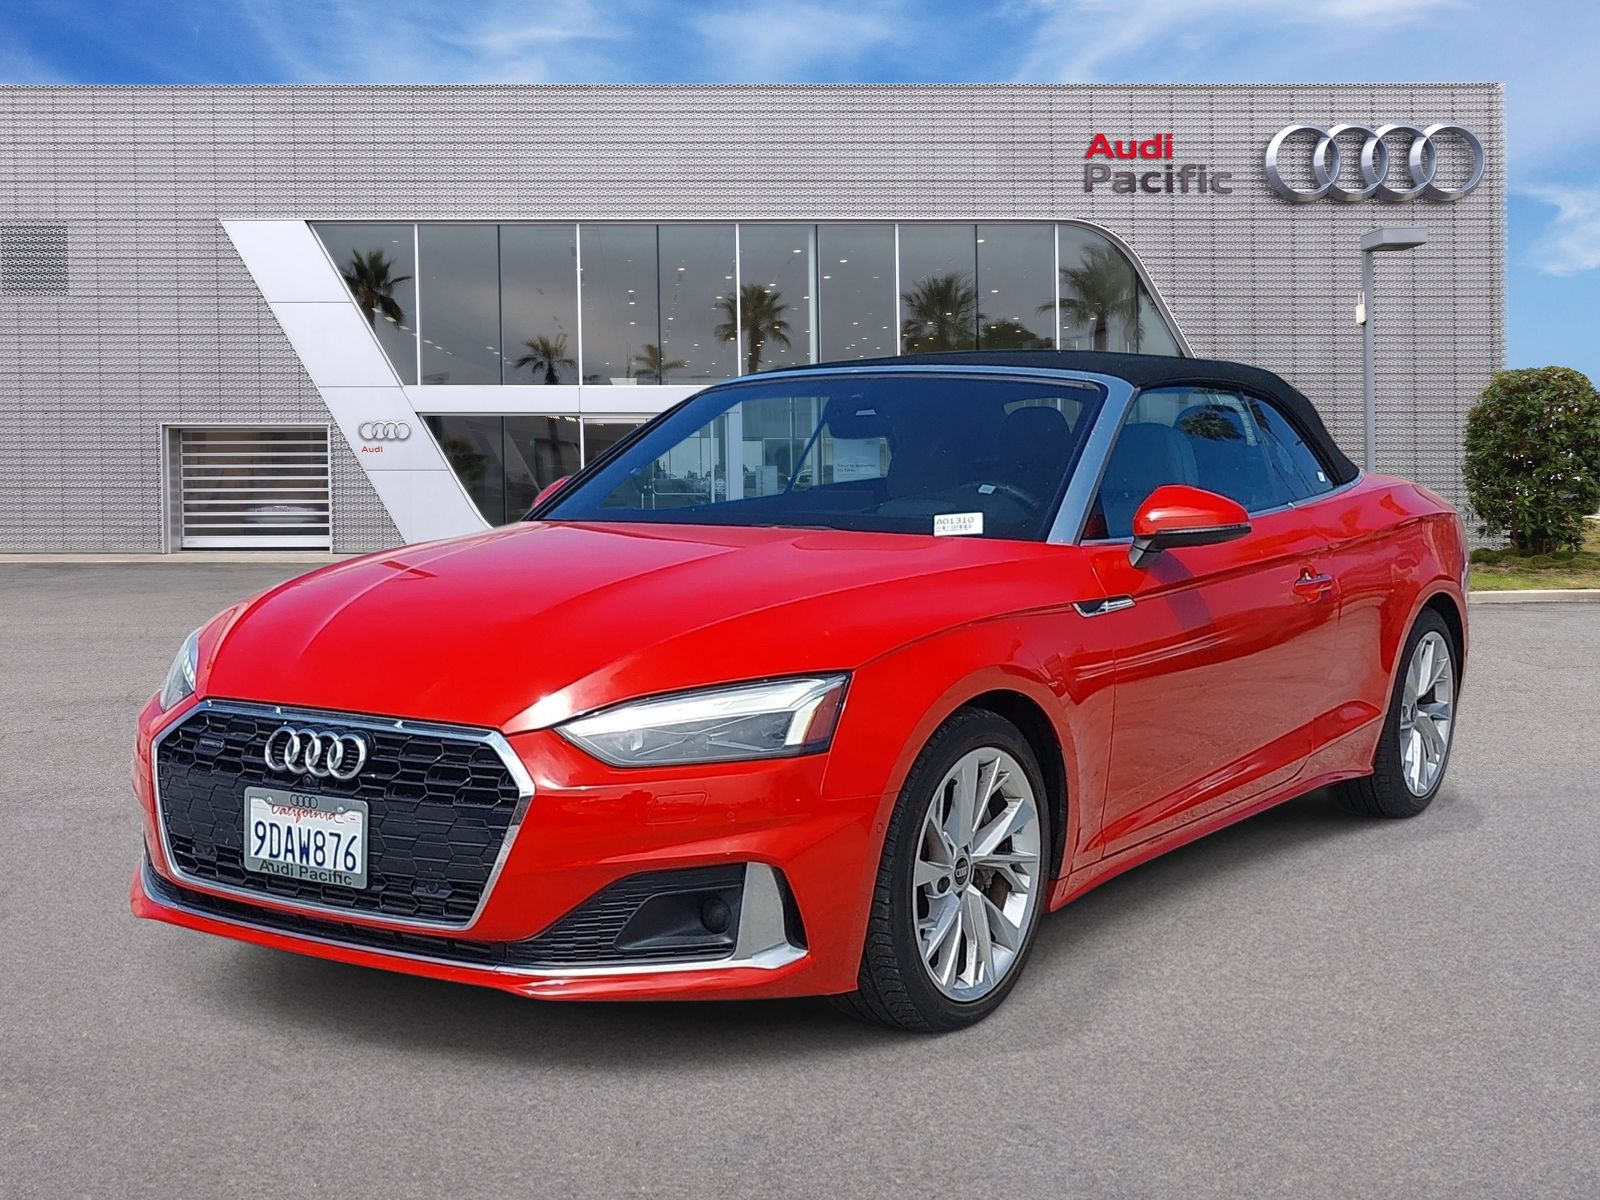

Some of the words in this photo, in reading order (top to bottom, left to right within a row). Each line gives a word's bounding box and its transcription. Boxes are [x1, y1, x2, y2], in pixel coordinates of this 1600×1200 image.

[1085, 133, 1174, 159] Audi
[1084, 162, 1233, 194] Pacific
[361, 445, 383, 453] Audi
[936, 516, 975, 525] A01310
[253, 820, 358, 871] 9DAW876
[259, 859, 294, 876] Audi
[299, 866, 352, 886] Pacific
